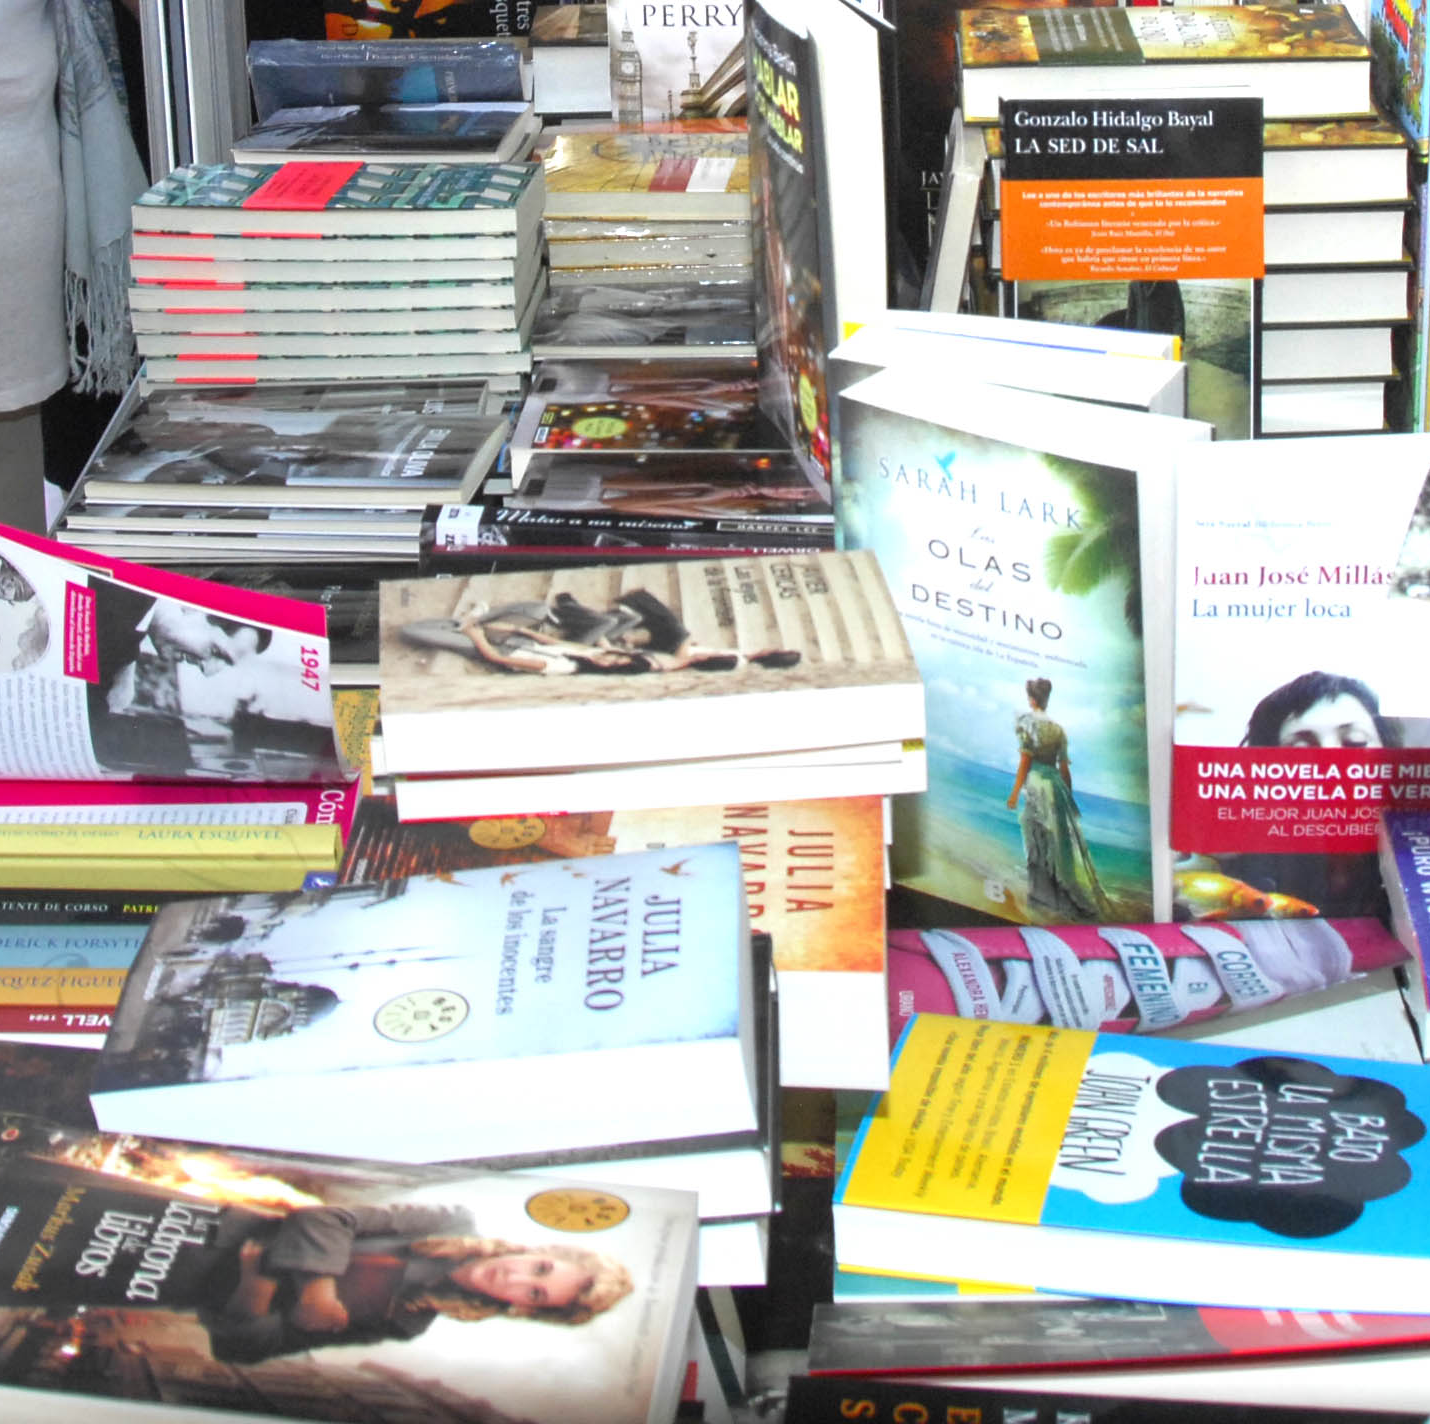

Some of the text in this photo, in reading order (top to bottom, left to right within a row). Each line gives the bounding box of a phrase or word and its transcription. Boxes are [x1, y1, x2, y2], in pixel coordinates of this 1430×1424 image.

[642, 3, 745, 28] PERRY
[1014, 109, 1215, 132] Gonzalo Hidalgo Bayal
[1014, 136, 1165, 155] LA SED DE SAL
[1146, 189, 1185, 200] brillantes
[877, 456, 1083, 531] SARAH LARK
[496, 508, 567, 527] Matar
[587, 519, 613, 529] un
[927, 538, 1032, 585] OLAS
[1193, 561, 1395, 590] Juan José Millás
[911, 582, 1064, 643] DESTINO
[1192, 596, 1352, 624] La mujer loca
[299, 644, 321, 693] 1947
[1198, 762, 1245, 779] UNA
[1250, 762, 1341, 780] NOVELA
[1346, 763, 1395, 782] QUE
[1198, 784, 1246, 800] UNA
[1252, 784, 1348, 800] NOVELA
[1352, 784, 1384, 800] DE
[137, 827, 195, 841] LAURA
[198, 828, 284, 843] ESQUIVEL
[1217, 806, 1348, 822] EL MEJOR JUAN
[1267, 823, 1287, 838] AL
[785, 828, 835, 915] JULIA
[44, 902, 61, 913] DE
[64, 903, 109, 914] CORSO
[508, 910, 529, 936] los
[533, 922, 562, 985] sangre
[583, 877, 632, 1013] NAVARRO
[640, 895, 682, 978] JULIA
[495, 938, 527, 1015] inocentes
[1078, 1068, 1153, 1118] JOHN
[1057, 1114, 1135, 1176] GREEN
[1192, 1077, 1265, 1187] ESTRELLA
[1258, 1081, 1335, 1187] LA MISMA
[1326, 1108, 1387, 1163] BAJO
[74, 1207, 154, 1279] libros
